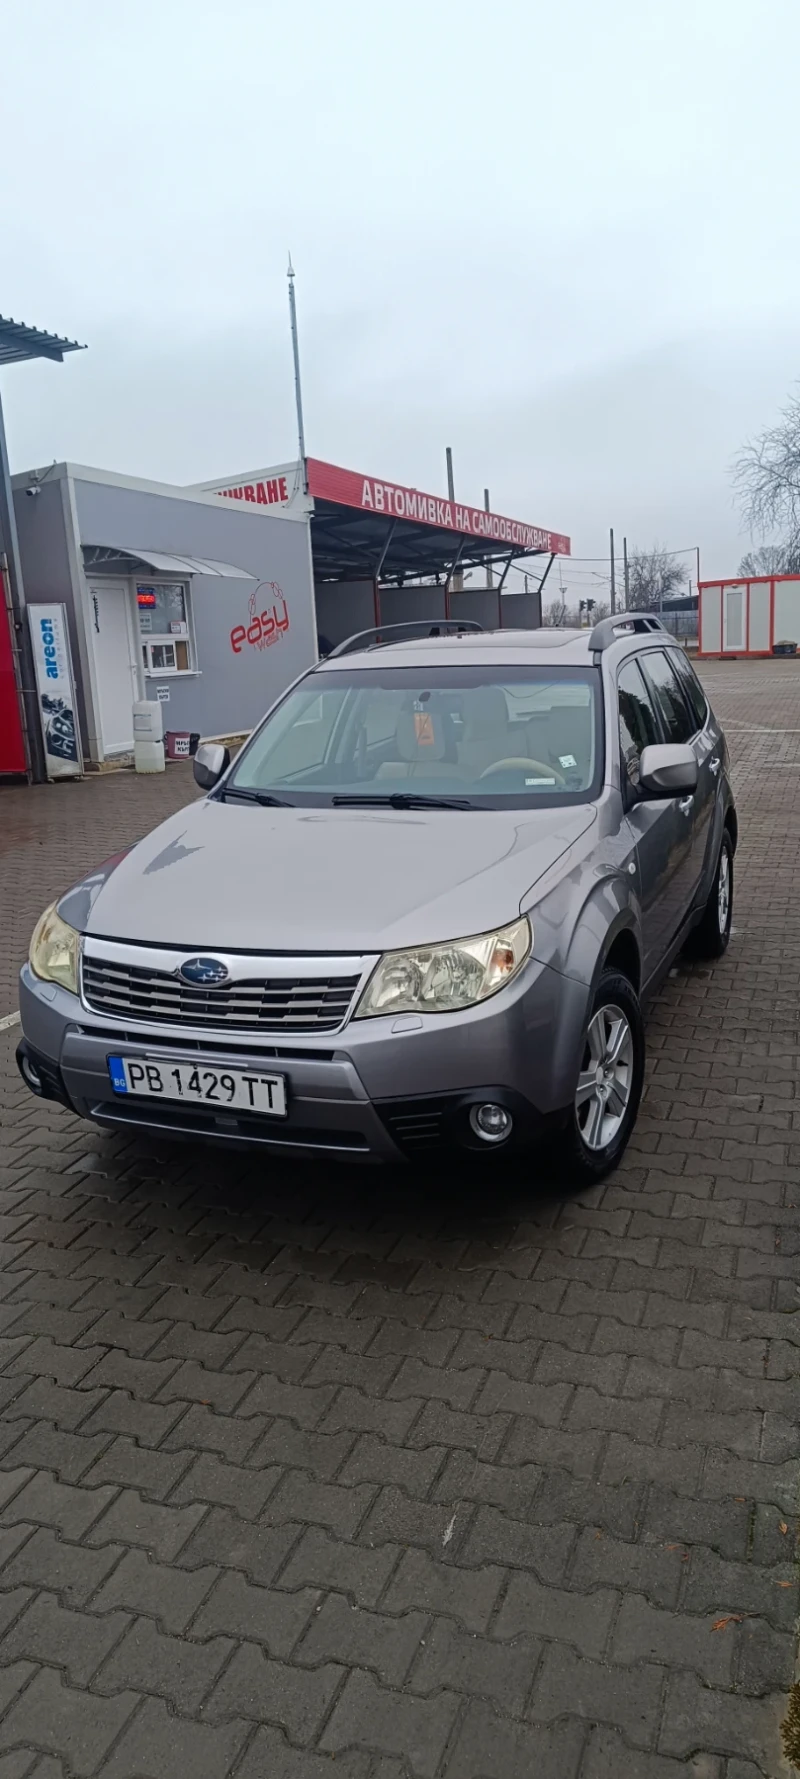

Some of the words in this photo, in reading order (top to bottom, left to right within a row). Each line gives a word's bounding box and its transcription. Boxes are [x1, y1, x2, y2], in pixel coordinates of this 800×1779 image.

[361, 479, 453, 528] АВТОМИВКА
[455, 506, 470, 531] НА
[472, 511, 552, 550] САМООБСЛУЖВАНЕ
[40, 618, 59, 680] areon
[230, 599, 290, 654] easy
[114, 1078, 126, 1087] BG
[128, 1063, 164, 1092] PB
[171, 1068, 236, 1102] 1429
[242, 1076, 278, 1109] TT
